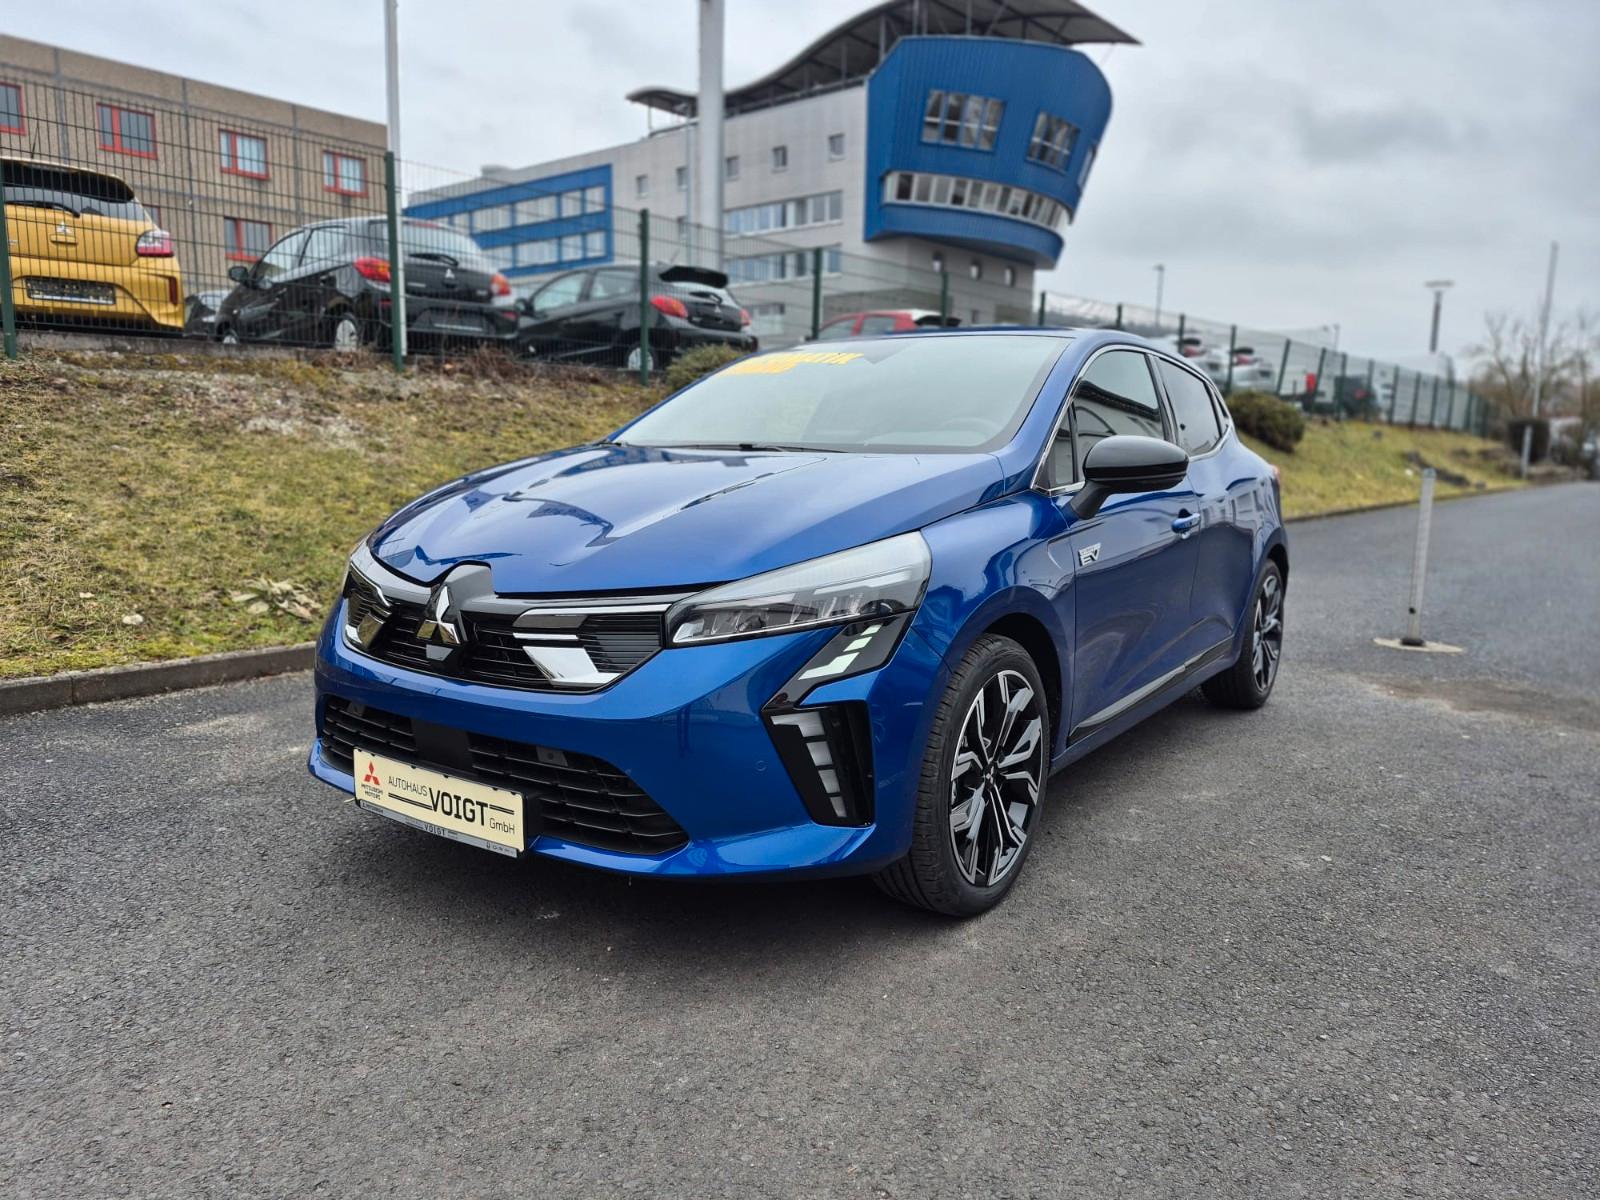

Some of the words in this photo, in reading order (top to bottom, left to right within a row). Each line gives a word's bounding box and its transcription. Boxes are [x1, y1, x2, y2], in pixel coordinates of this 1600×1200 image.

[388, 776, 428, 796] AUTOHAUS
[429, 788, 490, 826] VOIGT
[489, 818, 515, 835] GmbH
